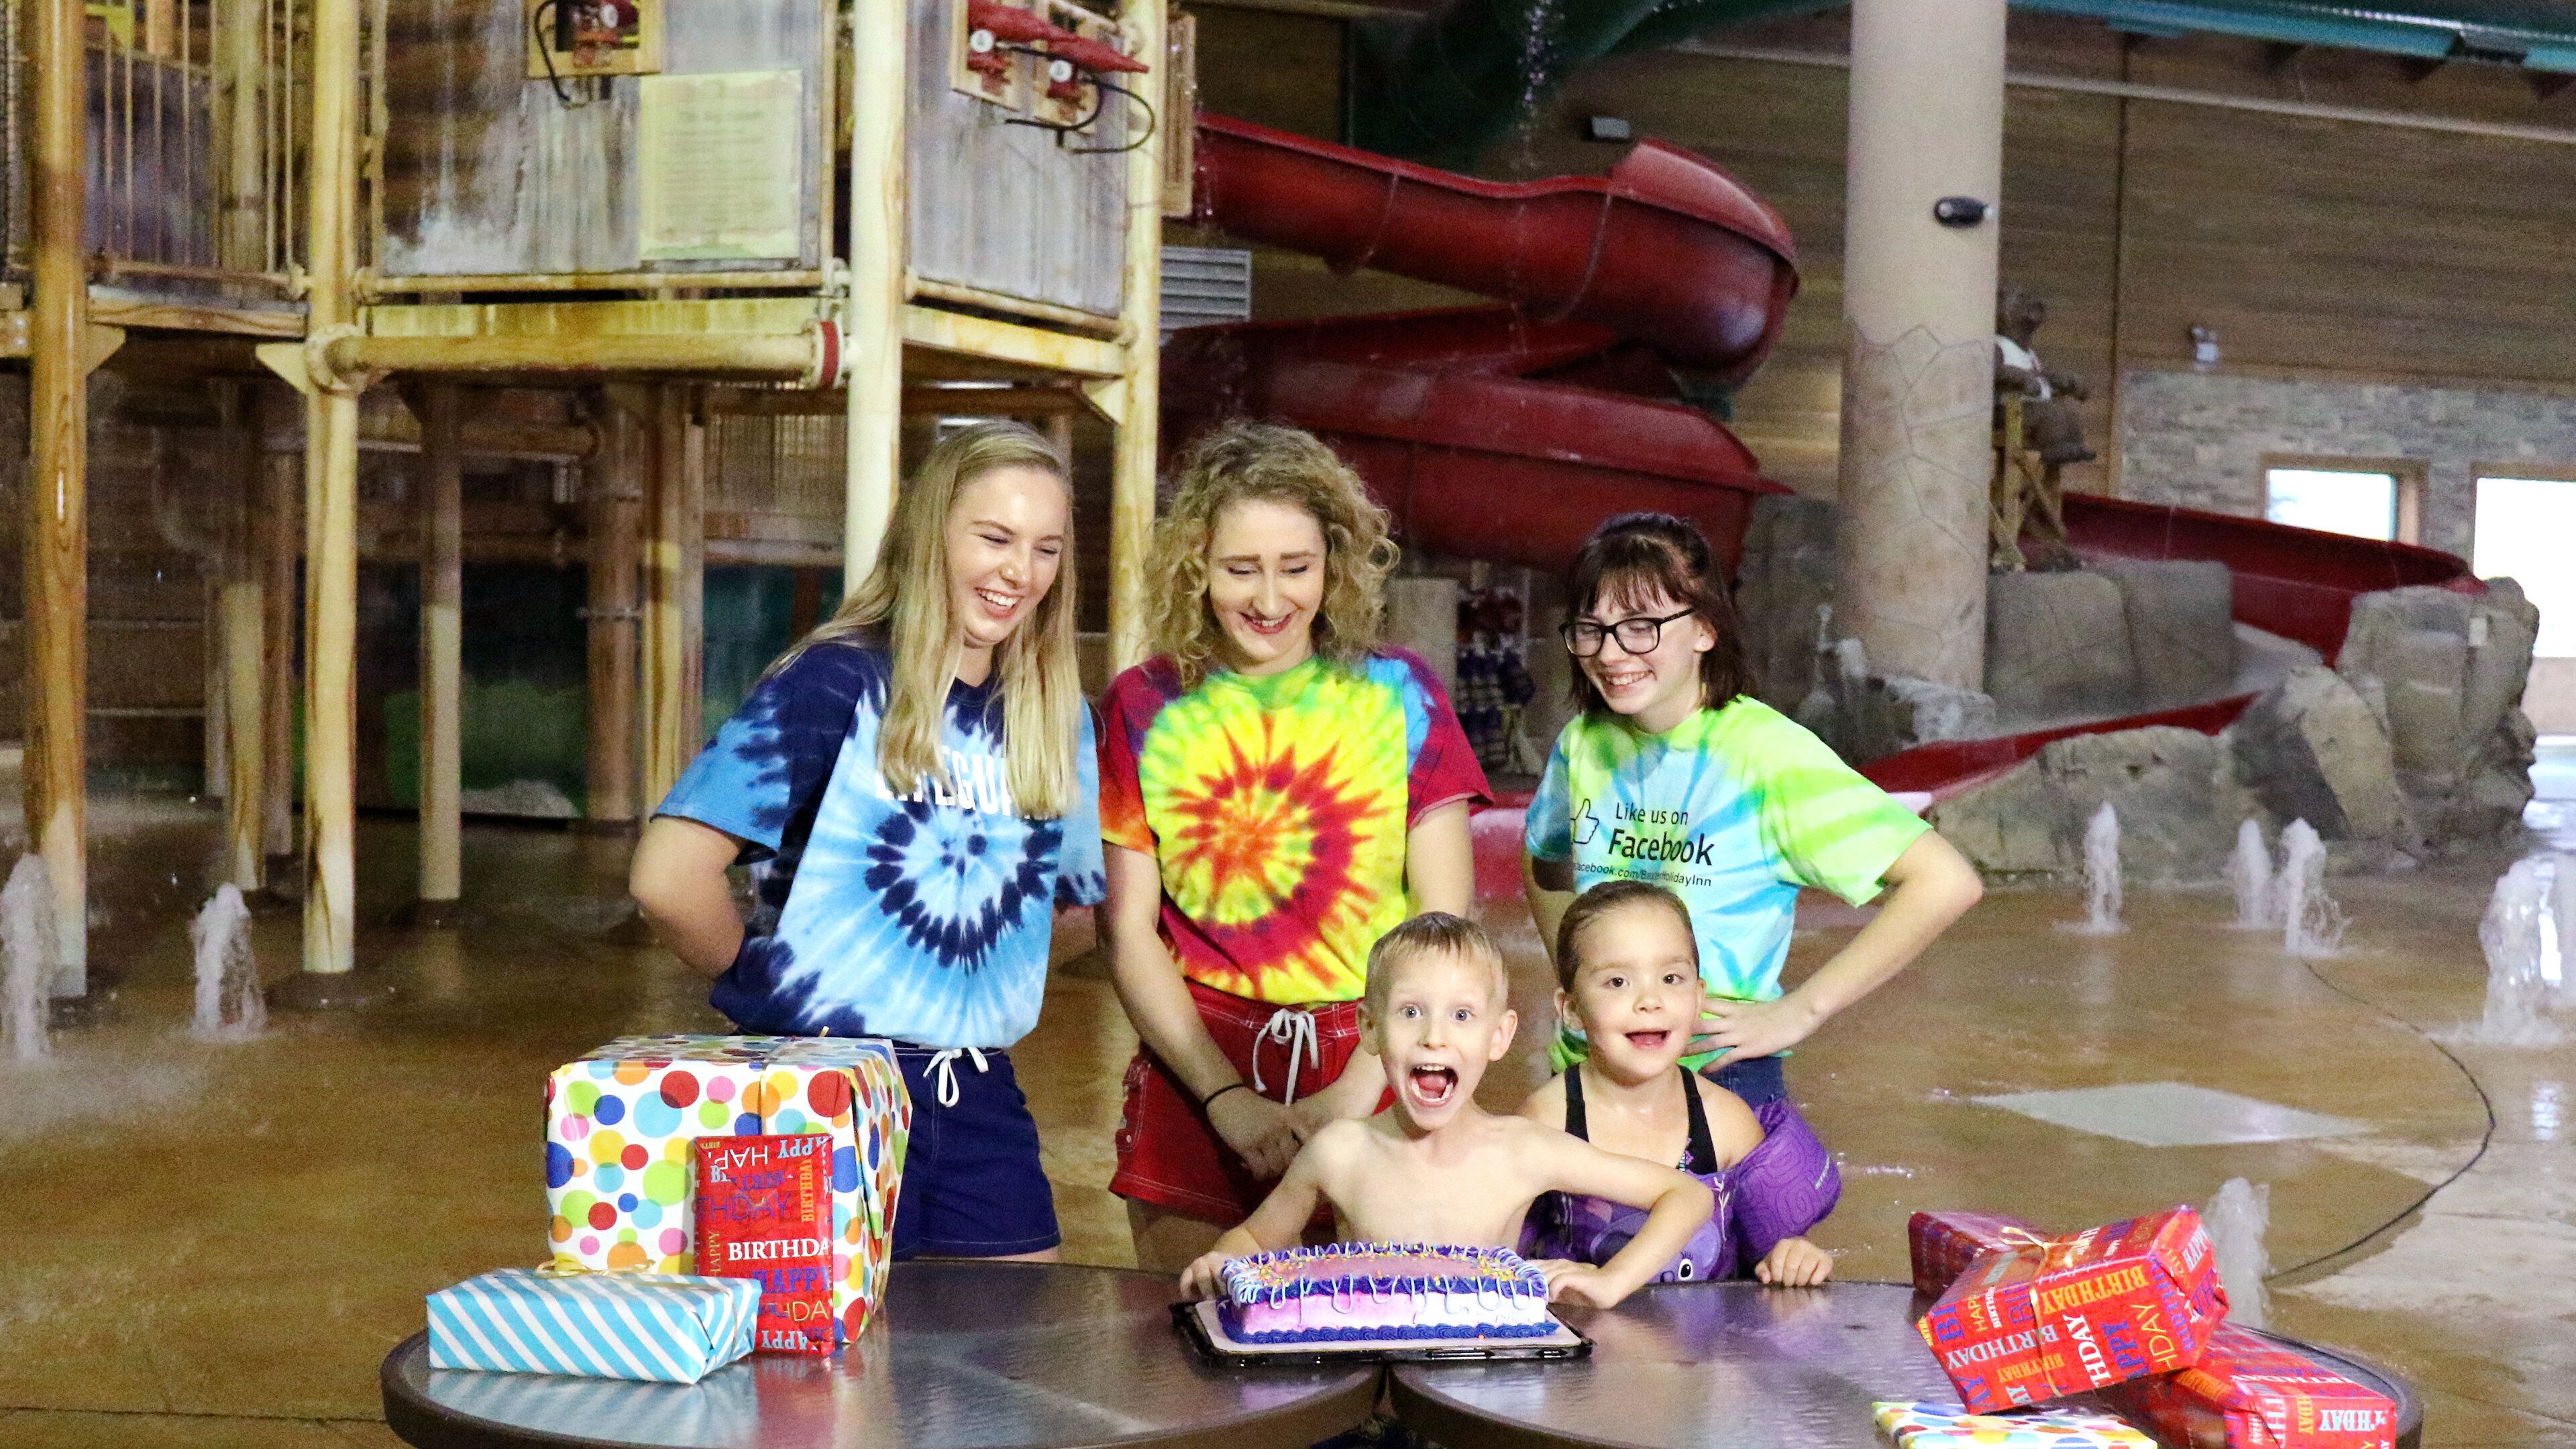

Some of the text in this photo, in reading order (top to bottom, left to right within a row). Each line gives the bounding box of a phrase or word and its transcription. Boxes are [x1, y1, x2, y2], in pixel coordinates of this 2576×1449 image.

[1615, 802, 1689, 826] Like us on
[1607, 827, 1715, 867] Facebook
[708, 1144, 769, 1170] HAP
[2039, 1265, 2149, 1316] BIRTHDAY
[1945, 1324, 2060, 1371] BIRTHDAY
[1996, 1352, 2065, 1383] BIRTHDAY
